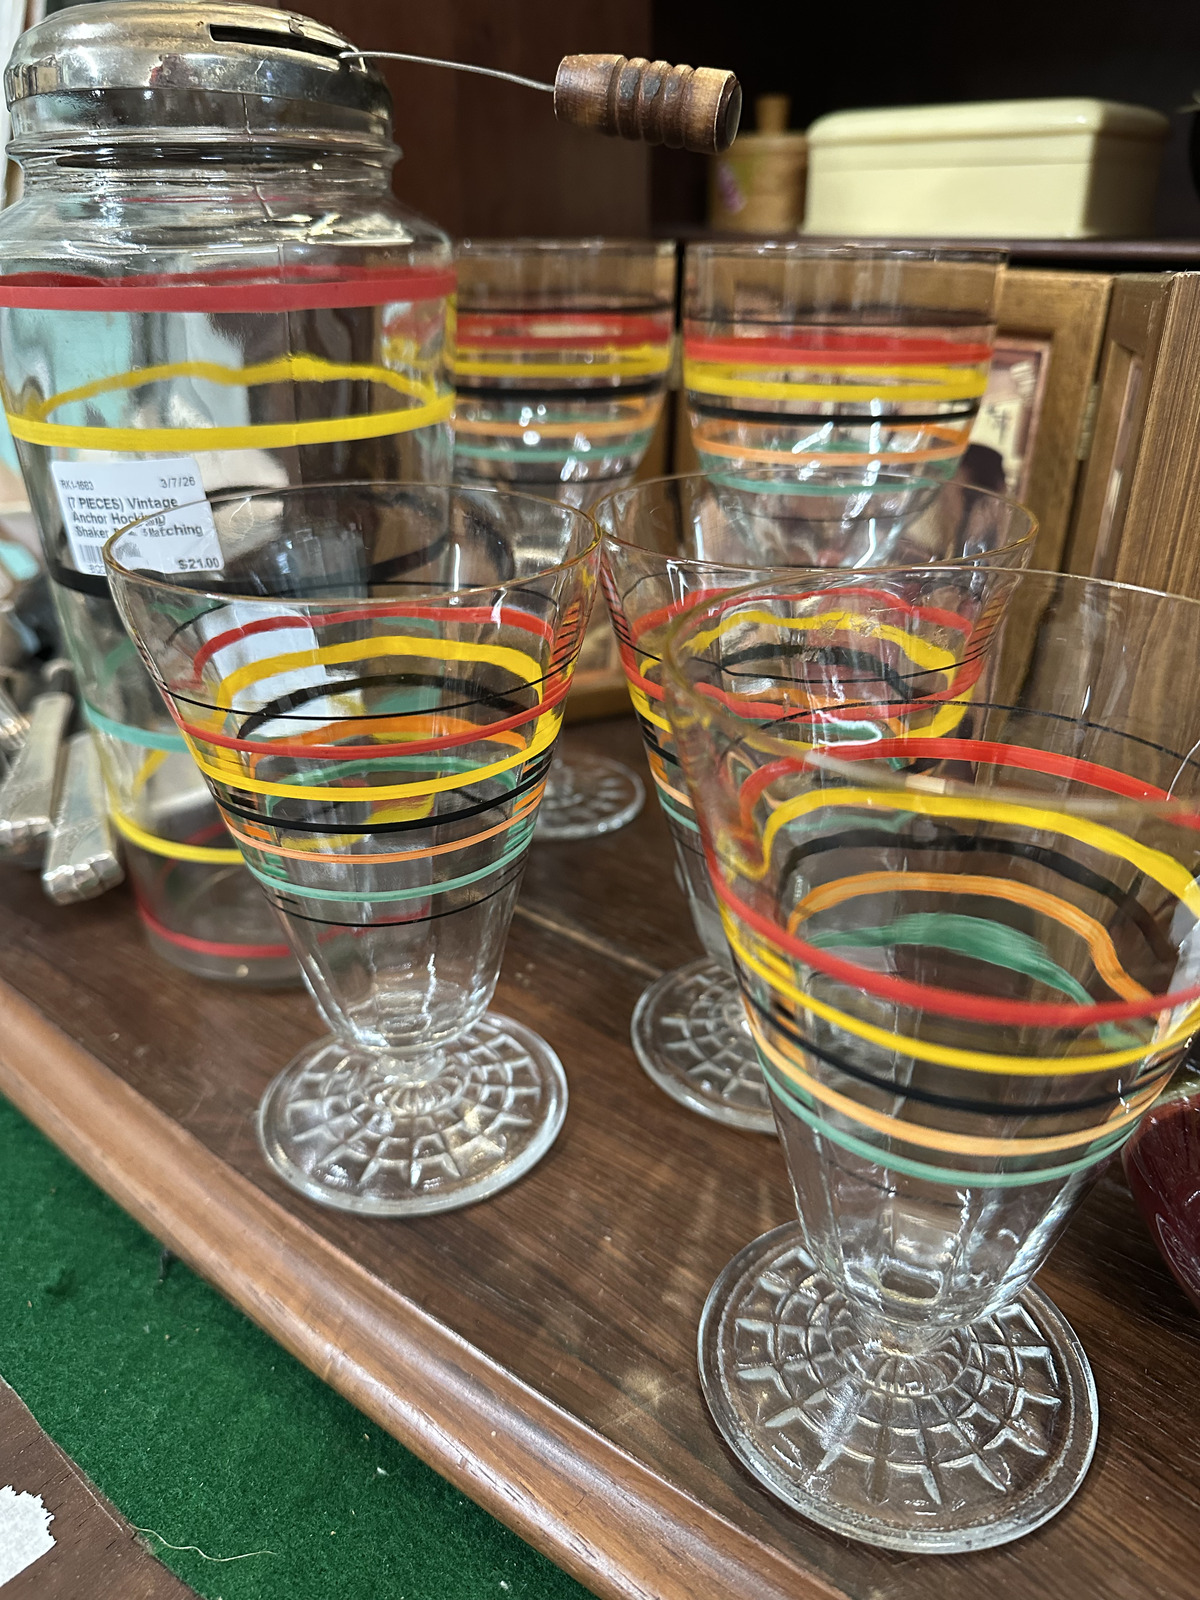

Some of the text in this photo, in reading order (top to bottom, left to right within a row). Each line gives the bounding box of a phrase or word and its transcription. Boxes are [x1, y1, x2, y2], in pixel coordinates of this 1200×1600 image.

[160, 476, 196, 489] 3/7/26
[68, 497, 178, 511] (7 PIECES) Vintage
[73, 512, 166, 527] Anchor Hock
[75, 526, 109, 538] Shaker
[178, 557, 220, 570] $21.00
